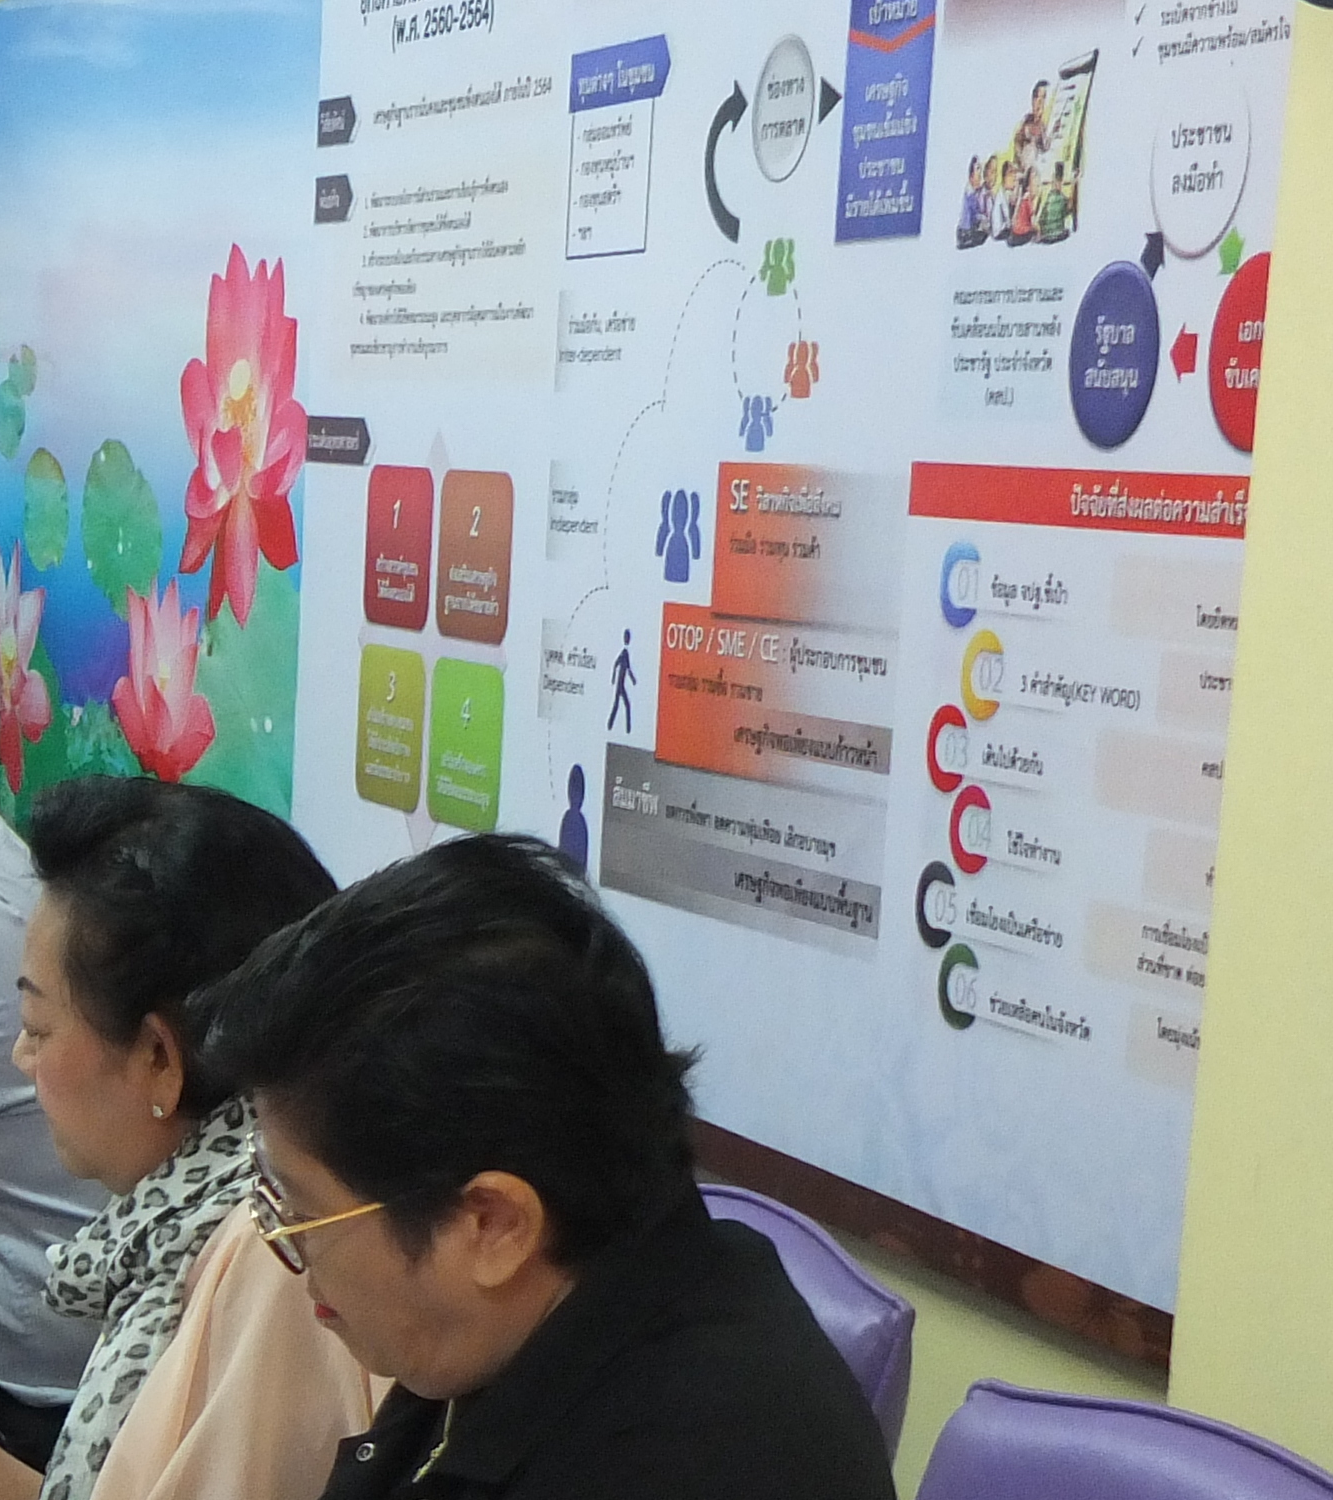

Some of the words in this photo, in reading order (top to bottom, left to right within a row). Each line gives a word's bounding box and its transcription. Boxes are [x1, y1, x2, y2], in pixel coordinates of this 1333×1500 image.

[424, 0, 495, 41] 2560-2564)
[1171, 122, 1232, 150] ประชาชน
[1171, 160, 1223, 196] ลงมือทำ
[1095, 315, 1136, 355] รัฐบาล
[1084, 358, 1139, 397] สนับสนุน
[730, 478, 750, 512] SE
[469, 504, 481, 537] 2
[666, 622, 704, 652] OTOP
[717, 628, 747, 658] SME
[760, 634, 779, 664] CE
[1100, 687, 1141, 712] WORD)
